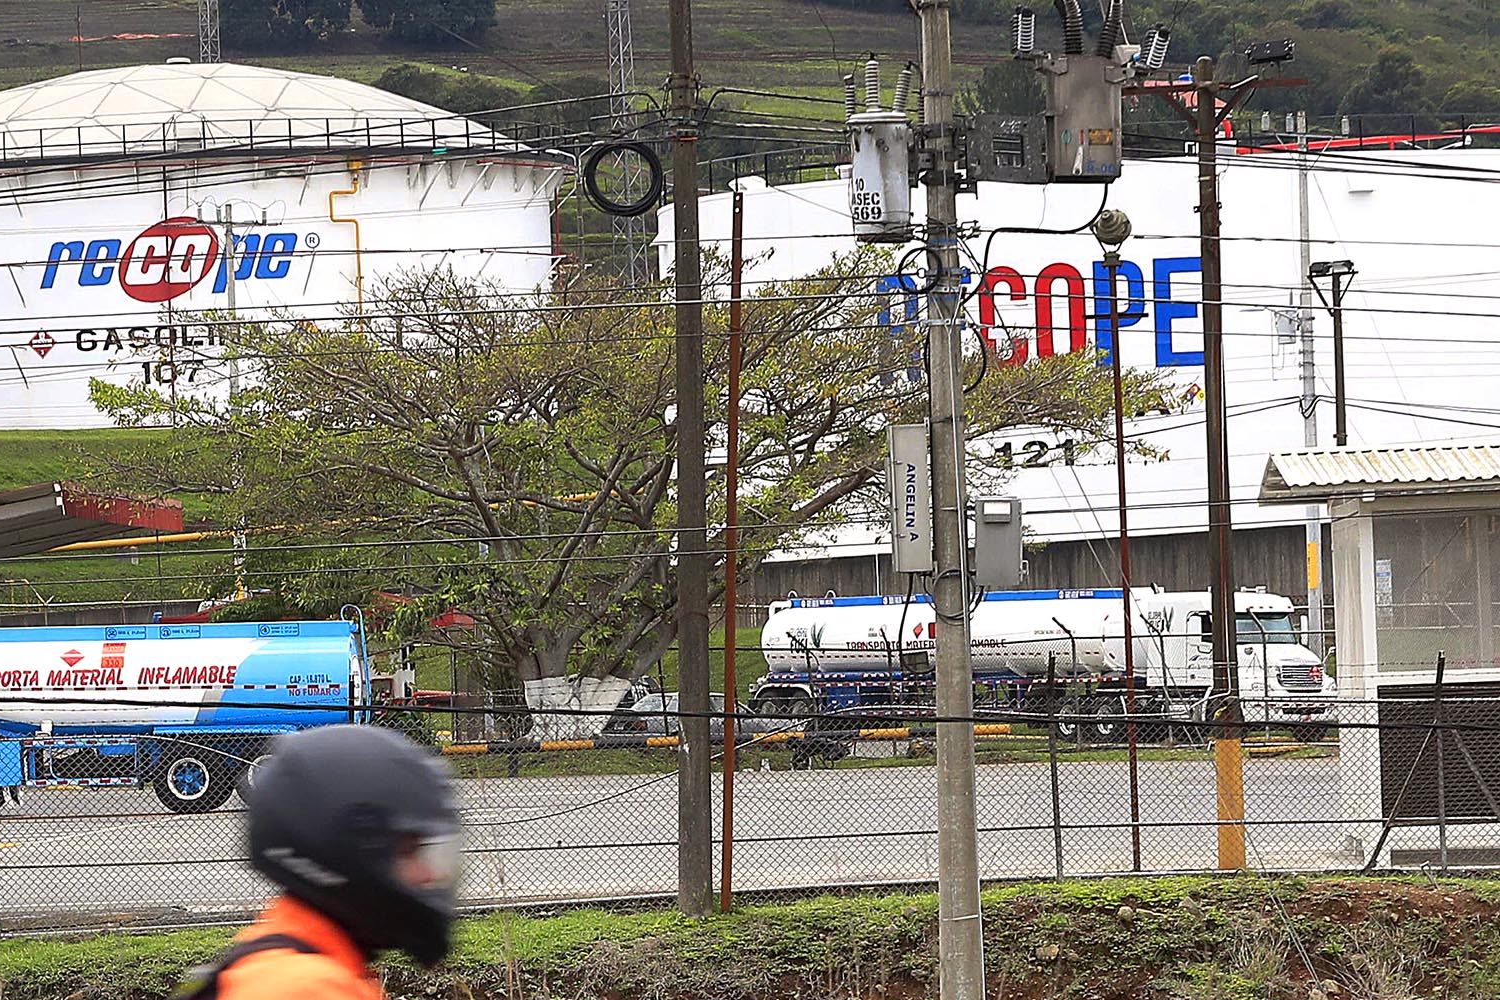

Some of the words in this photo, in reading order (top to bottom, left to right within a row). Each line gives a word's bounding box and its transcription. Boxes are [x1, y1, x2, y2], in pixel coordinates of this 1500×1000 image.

[994, 438, 1075, 469] 121
[46, 668, 124, 686] MATERIAL
[138, 665, 238, 685] INFLAMABLE
